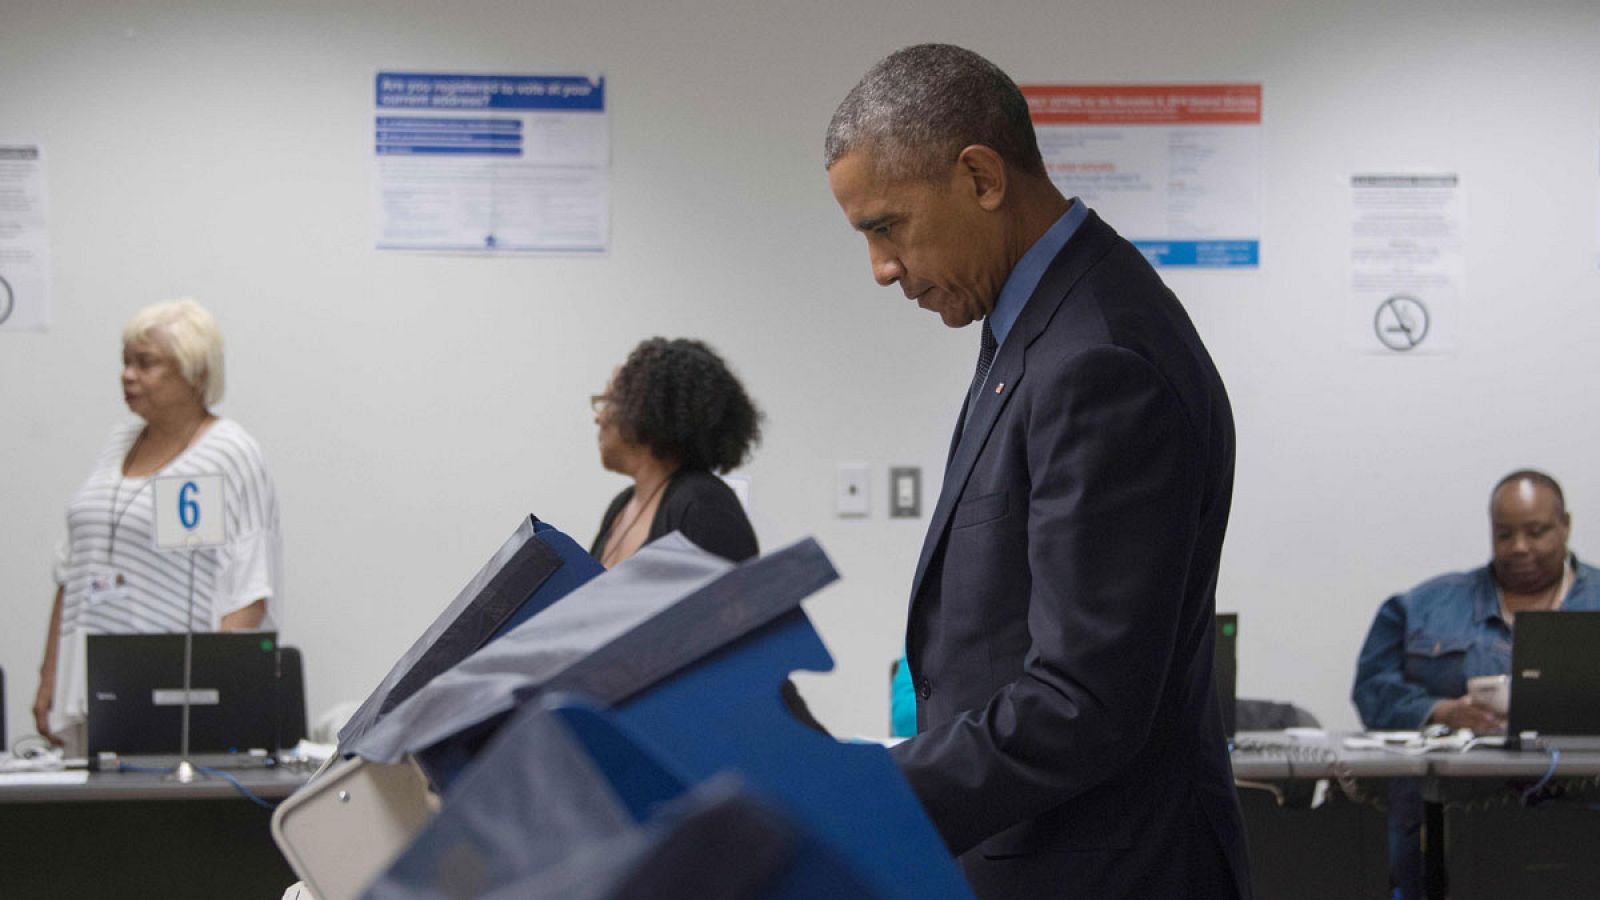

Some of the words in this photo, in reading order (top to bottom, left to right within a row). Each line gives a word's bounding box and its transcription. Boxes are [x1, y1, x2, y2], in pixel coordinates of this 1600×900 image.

[383, 79, 403, 91] Are
[407, 82, 430, 95] you
[434, 80, 498, 96] registered
[500, 83, 513, 95] to
[518, 82, 545, 96] vote
[562, 85, 592, 99] your
[383, 95, 429, 106] current
[178, 481, 200, 530] 6
